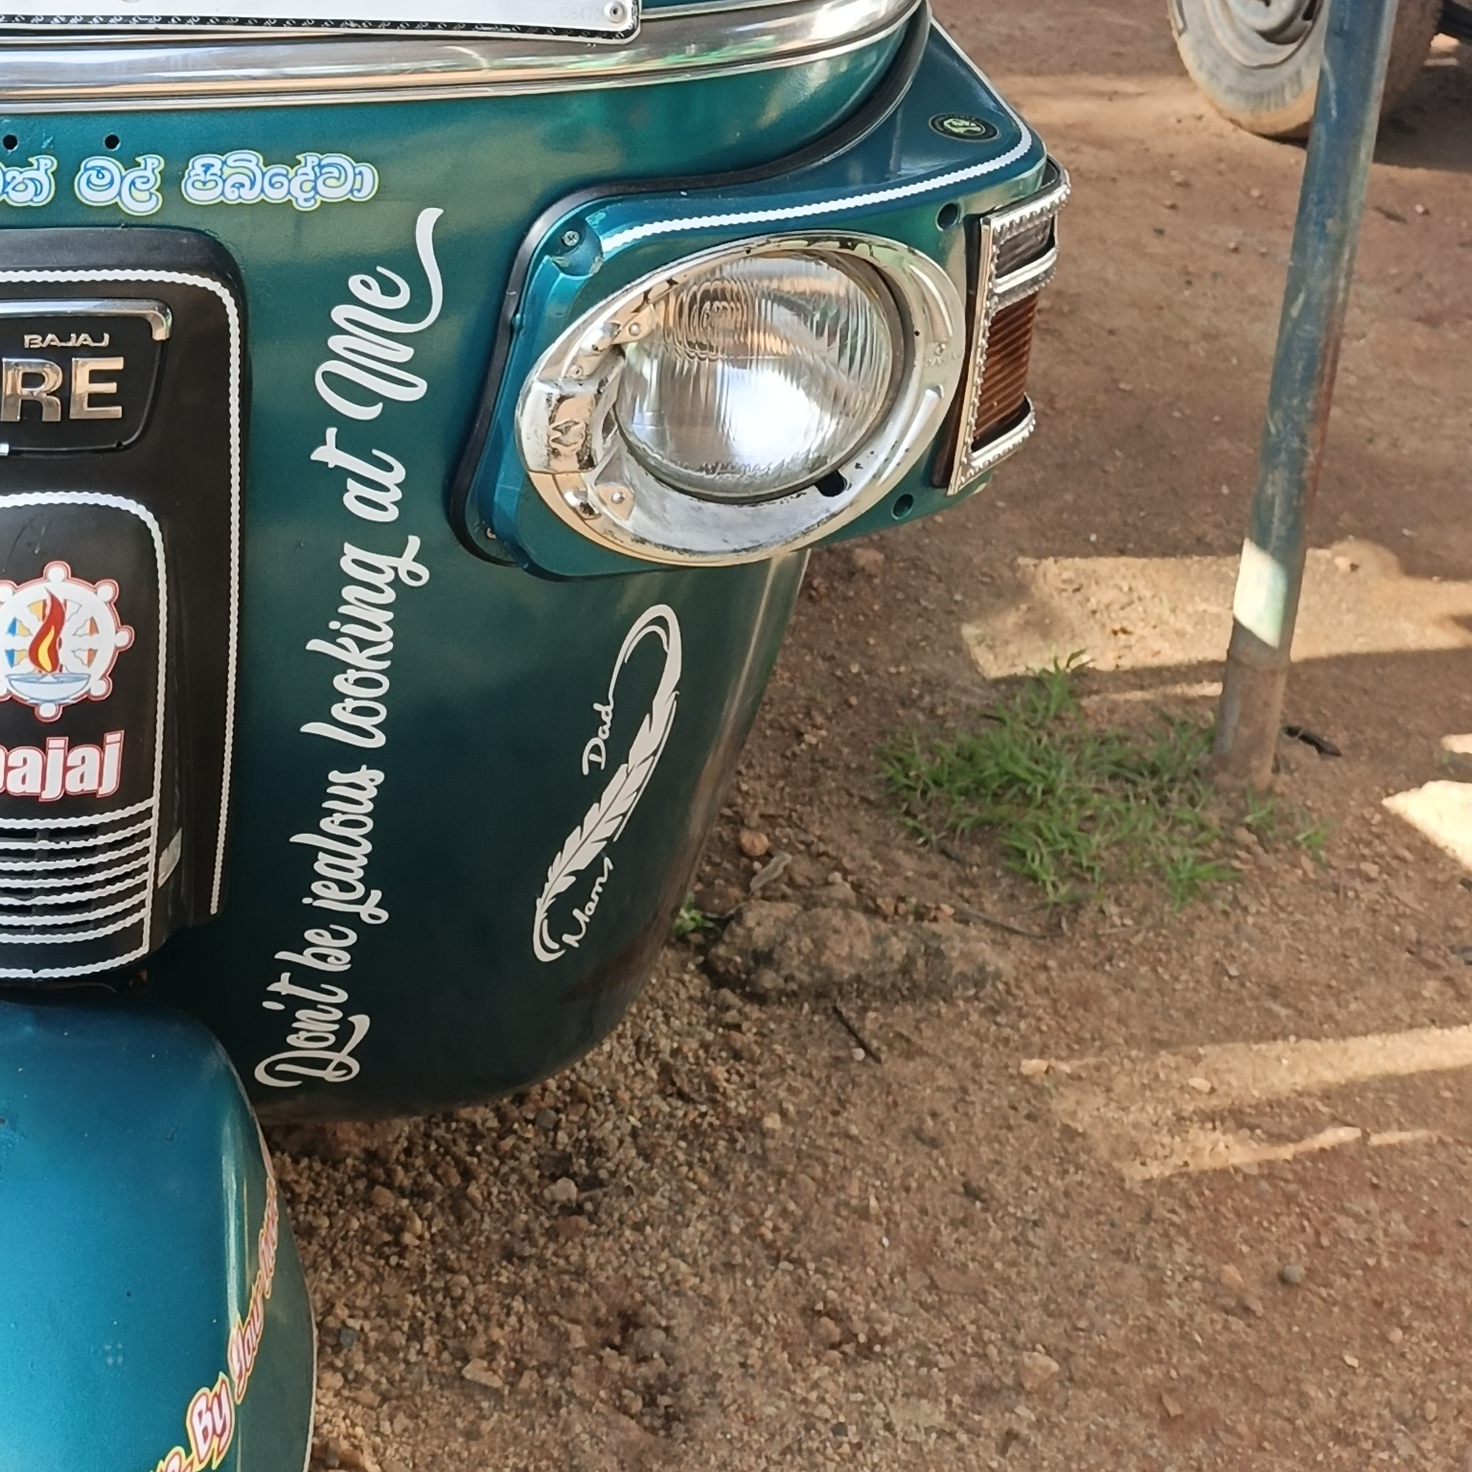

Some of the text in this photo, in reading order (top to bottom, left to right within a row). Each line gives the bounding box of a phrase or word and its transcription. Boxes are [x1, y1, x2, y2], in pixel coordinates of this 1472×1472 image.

[74, 154, 165, 216] මල්
[23, 332, 111, 349] BAJAJ
[0, 355, 125, 423] RE
[254, 207, 445, 1087] Don't be jealous looking at Me
[582, 701, 617, 776] Dad
[186, 1371, 234, 1471] By
